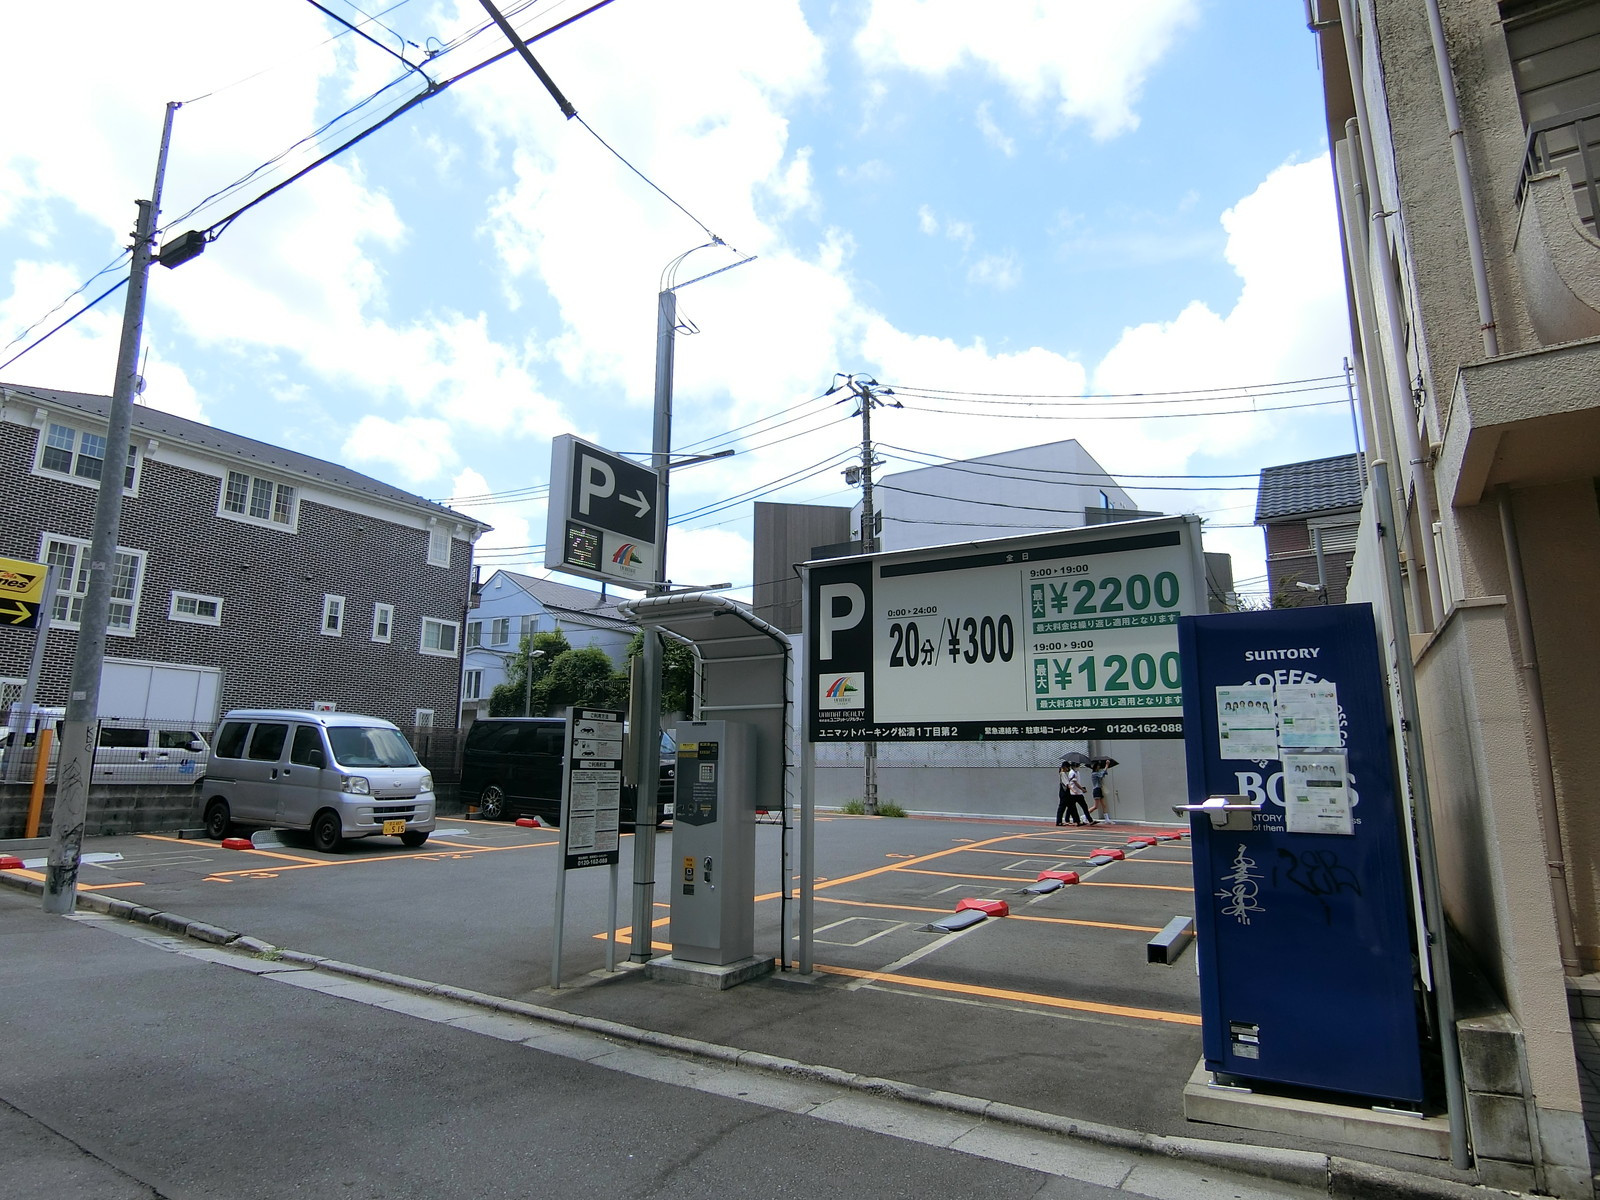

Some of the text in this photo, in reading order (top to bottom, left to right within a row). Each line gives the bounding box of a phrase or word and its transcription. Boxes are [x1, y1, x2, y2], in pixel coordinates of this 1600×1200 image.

[579, 453, 616, 516] P
[1029, 564, 1089, 577] 9:00 19:00
[1032, 590, 1044, 613] 最大
[1049, 571, 1180, 615] ¥2200
[887, 605, 938, 617] 0:00 24:00
[819, 582, 866, 661] P
[1032, 640, 1094, 651] 19:00 9:00
[1244, 647, 1321, 661] SUNTORY
[1035, 664, 1048, 689] 最大
[1052, 651, 1182, 692] ¥1200
[1106, 723, 1183, 734] 0120-162-088
[1263, 824, 1285, 832] them
